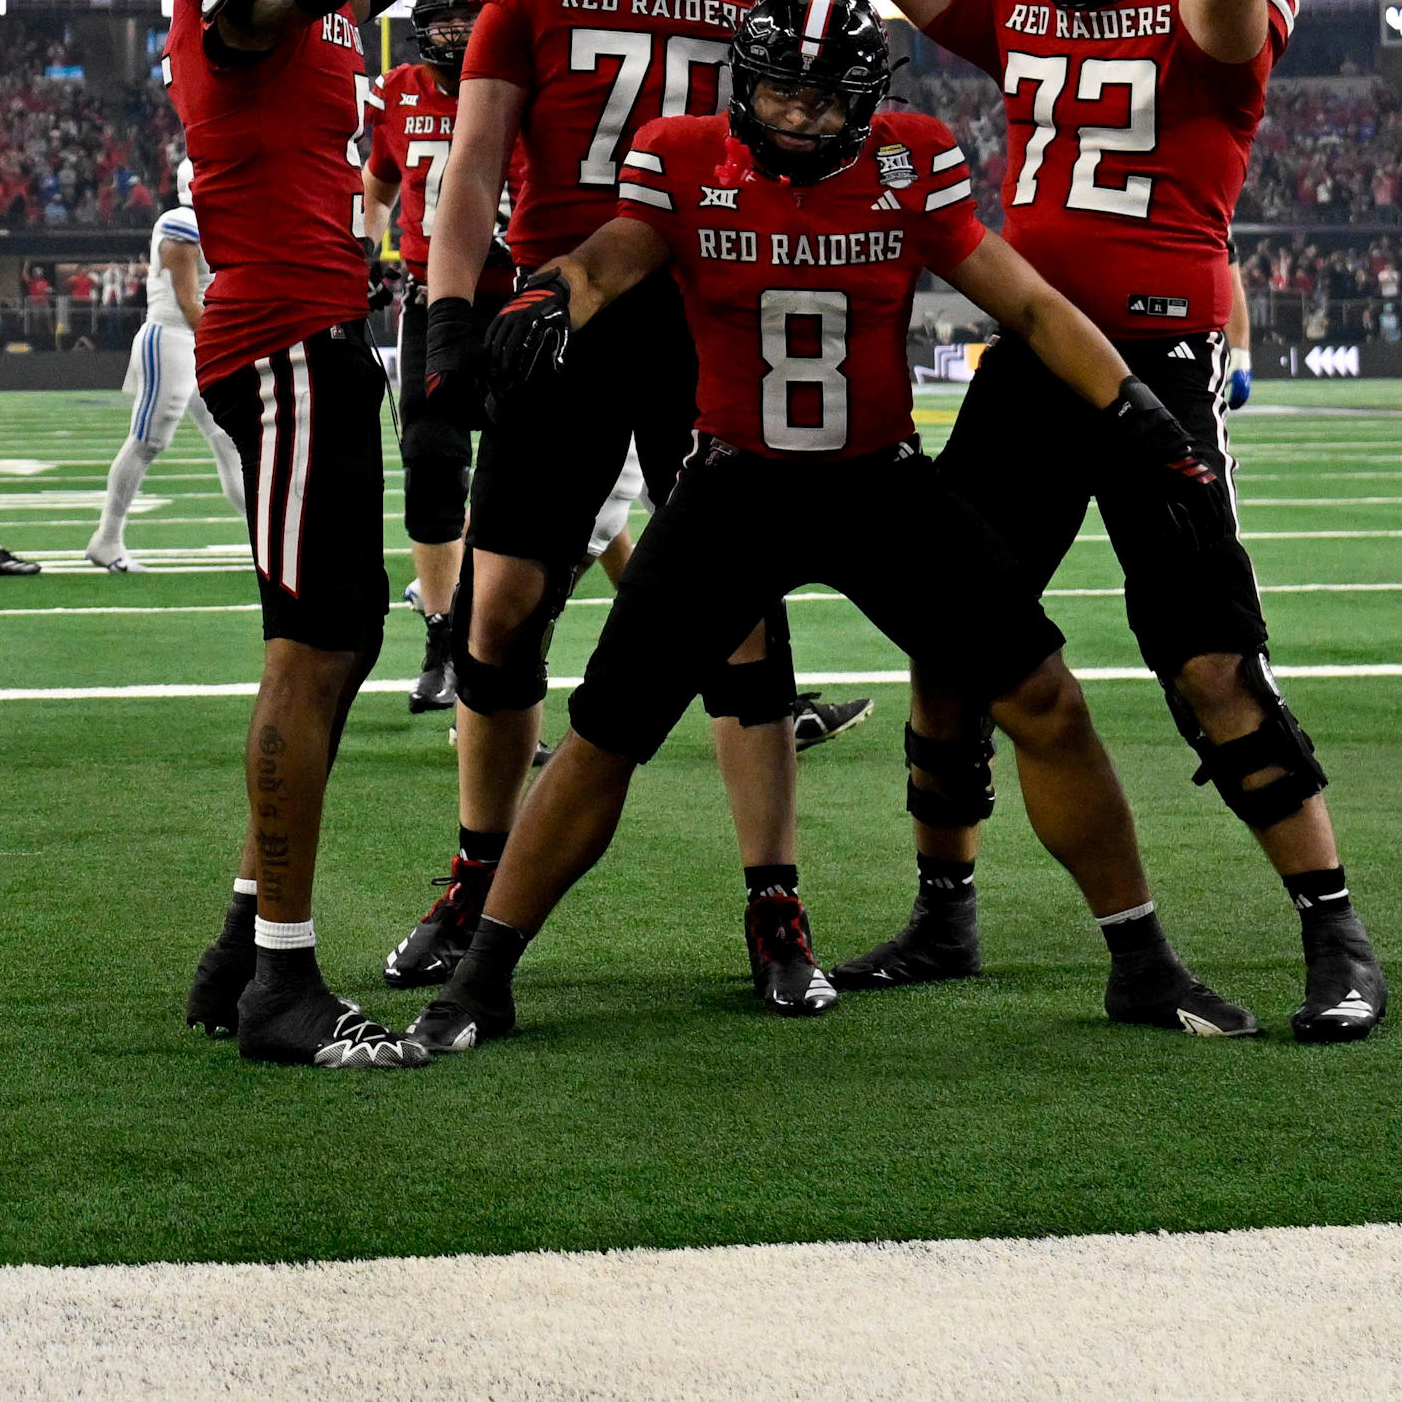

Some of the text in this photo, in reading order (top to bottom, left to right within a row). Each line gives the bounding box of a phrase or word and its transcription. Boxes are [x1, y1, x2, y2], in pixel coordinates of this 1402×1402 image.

[322, 12, 353, 50] RED
[1005, 4, 1173, 40] RED RAIDERS
[404, 115, 435, 135] RED
[570, 28, 735, 186] 70
[1004, 50, 1158, 219] 72
[699, 186, 740, 210] XII
[698, 228, 905, 266] RED RAIDERS
[760, 288, 849, 452] 8
